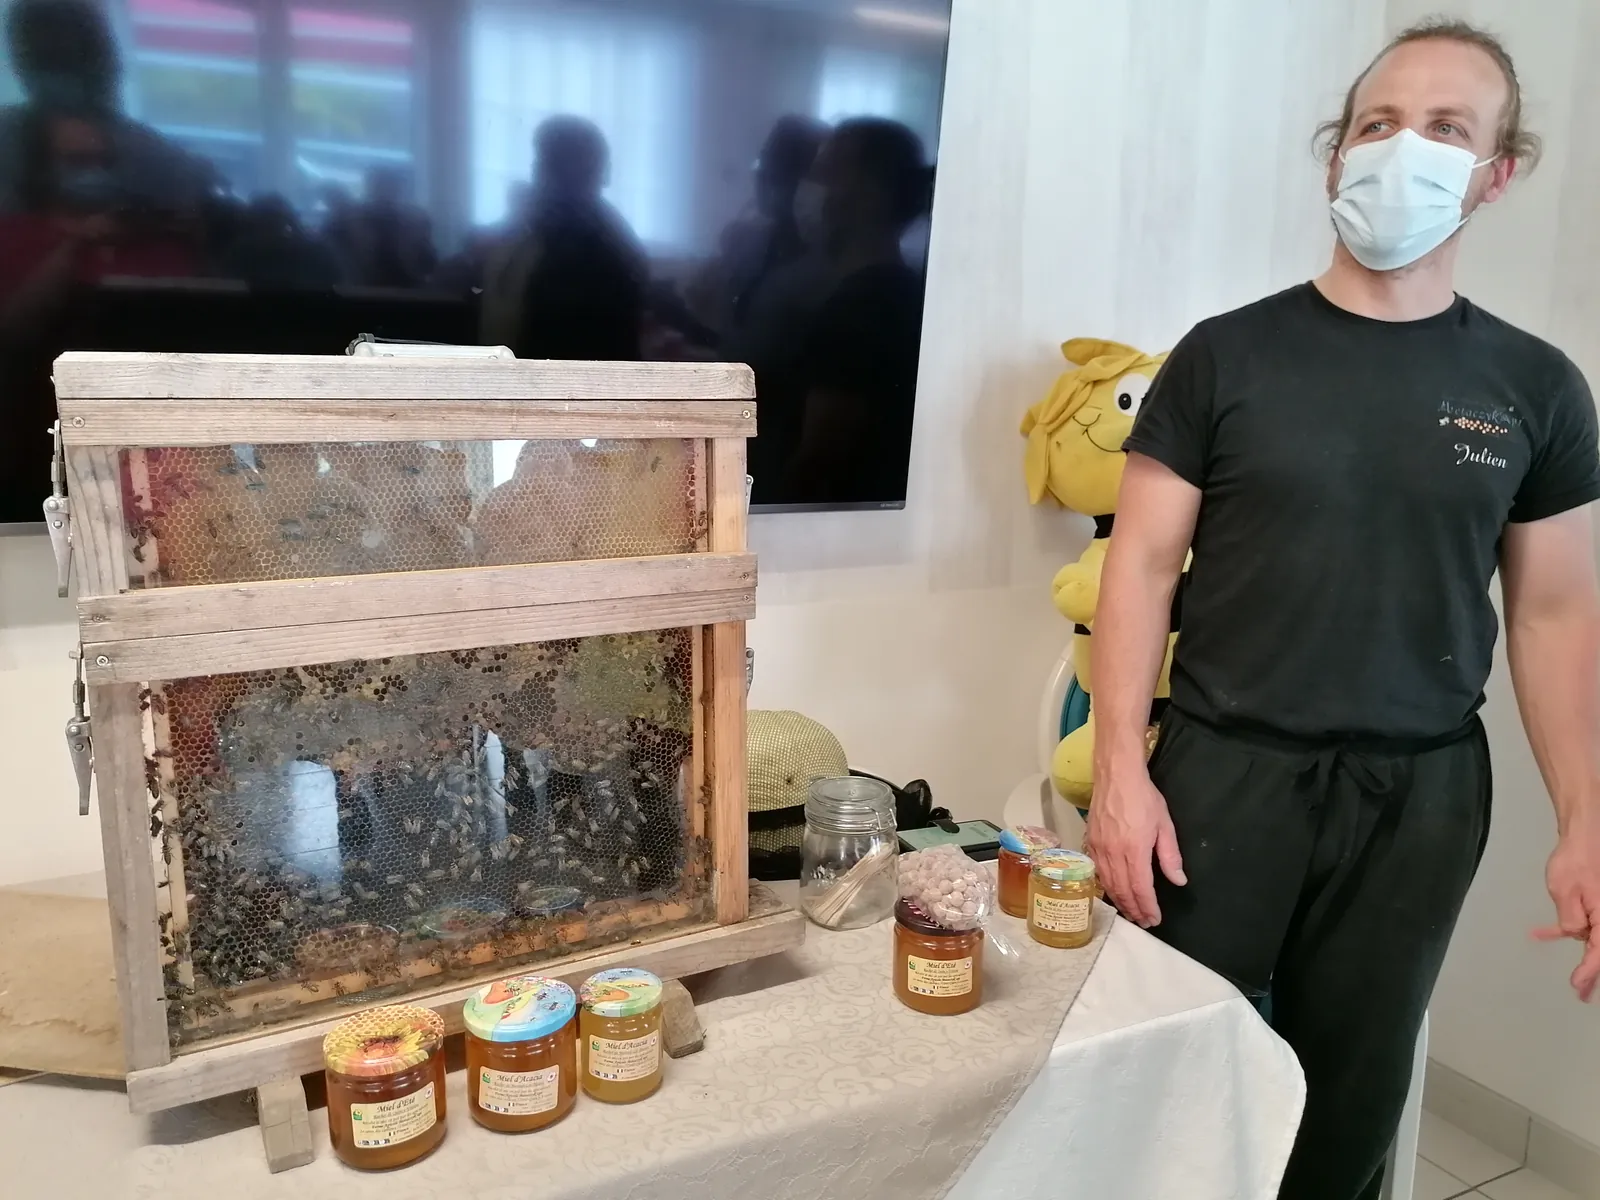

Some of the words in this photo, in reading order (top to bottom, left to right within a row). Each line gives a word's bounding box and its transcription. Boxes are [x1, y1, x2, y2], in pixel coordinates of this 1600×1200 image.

[1454, 443, 1507, 468] Julien
[605, 1042, 621, 1050] Miel
[496, 1074, 513, 1083] Miel
[514, 1073, 543, 1083] d'Acacia
[376, 1101, 395, 1113] Miel
